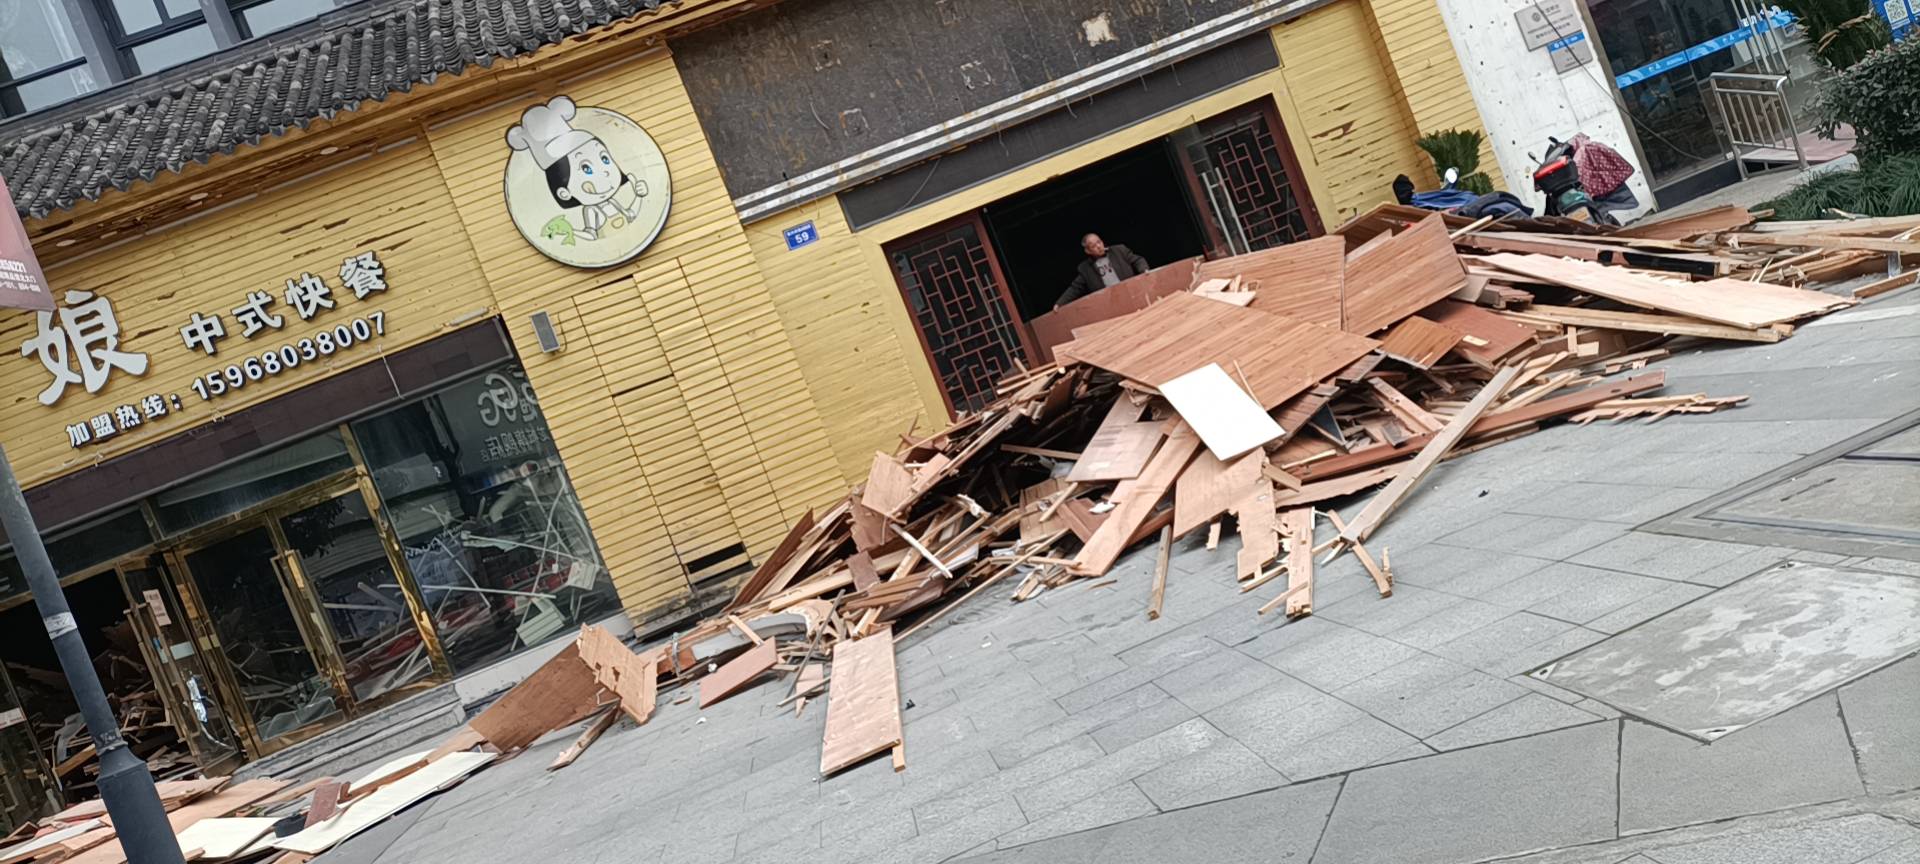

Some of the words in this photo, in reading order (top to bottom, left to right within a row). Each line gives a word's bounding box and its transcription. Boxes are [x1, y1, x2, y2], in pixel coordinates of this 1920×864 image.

[795, 231, 809, 243] 59
[21, 289, 148, 405] 娘
[178, 250, 387, 355] 中式快餐
[191, 311, 385, 400] 15968038007
